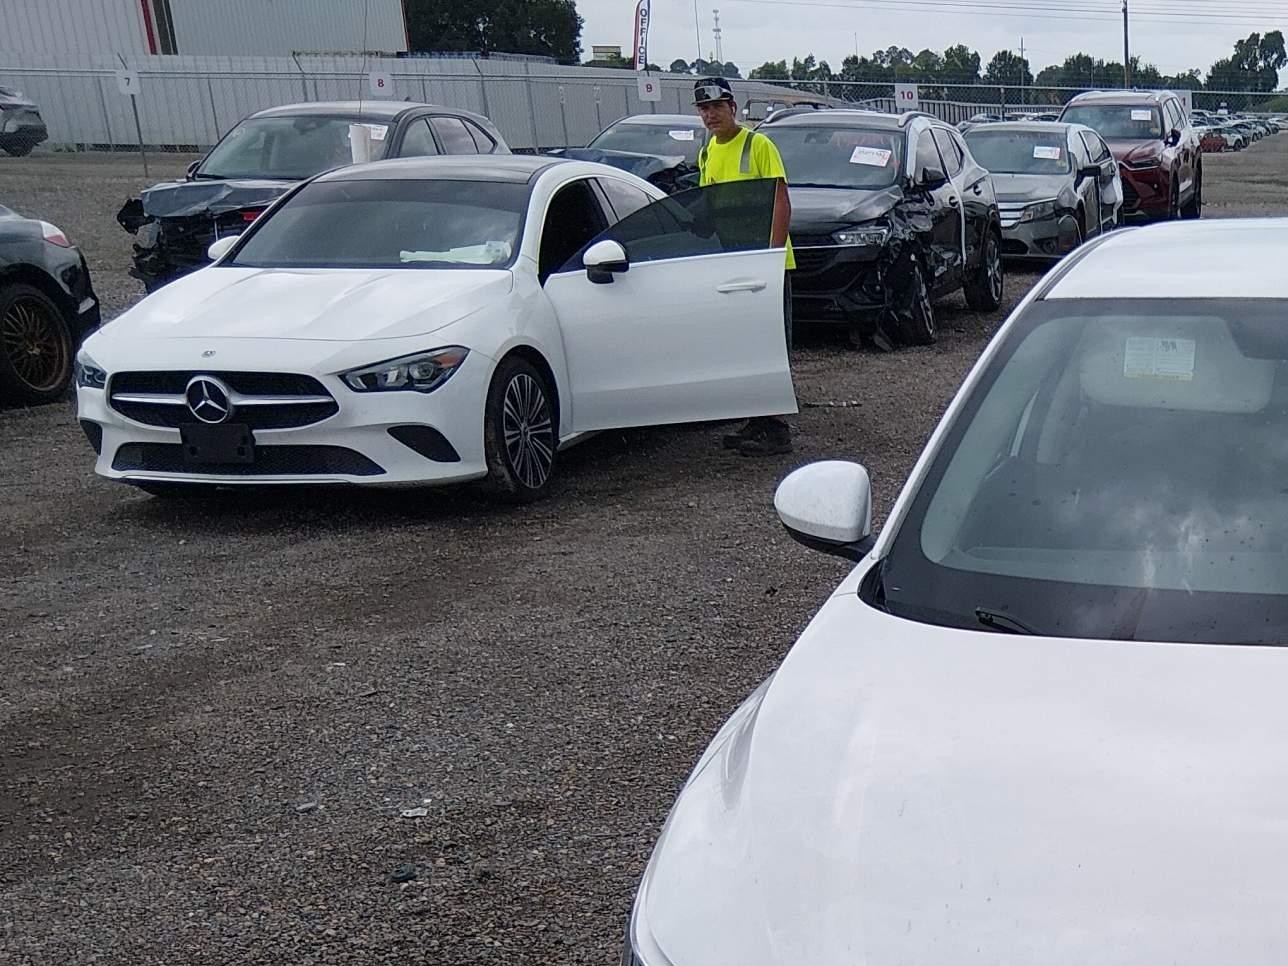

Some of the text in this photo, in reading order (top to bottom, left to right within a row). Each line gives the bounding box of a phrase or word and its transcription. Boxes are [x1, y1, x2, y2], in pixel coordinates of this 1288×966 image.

[638, 8, 648, 65] OFFICE
[377, 78, 385, 88] 8
[900, 90, 914, 101] 10
